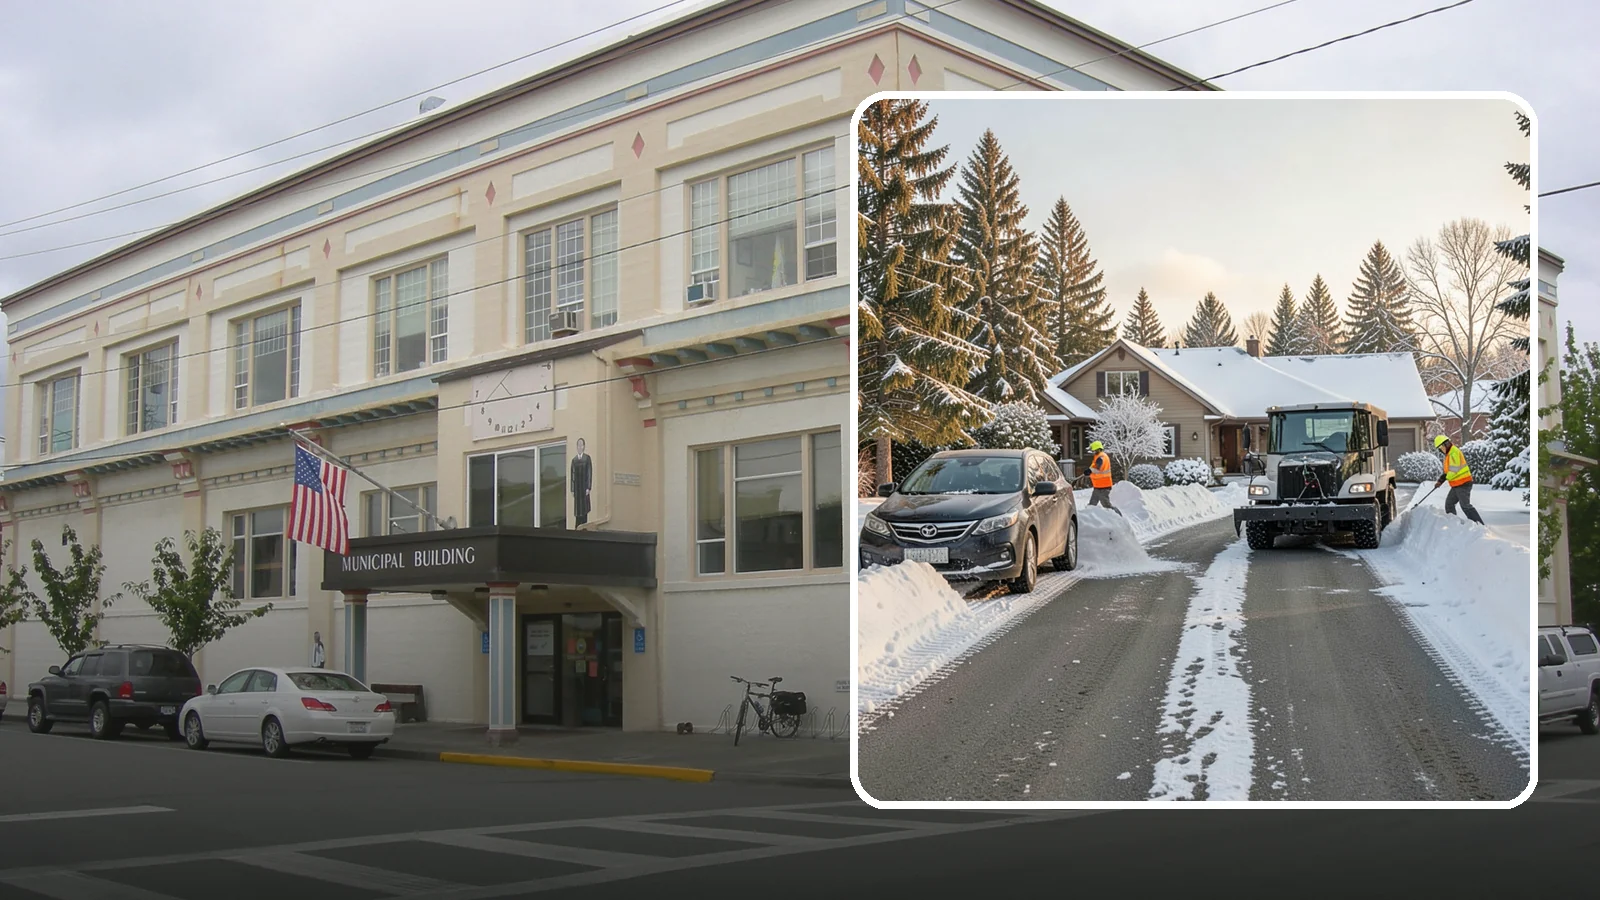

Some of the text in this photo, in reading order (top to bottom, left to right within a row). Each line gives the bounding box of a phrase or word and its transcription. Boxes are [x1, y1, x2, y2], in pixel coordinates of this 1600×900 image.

[480, 407, 485, 415] 8
[488, 418, 492, 426] 9
[528, 414, 532, 422] 3
[521, 420, 526, 428] 2
[508, 426, 513, 434] 12
[342, 546, 475, 572] MUNICIPAL BUILDING
